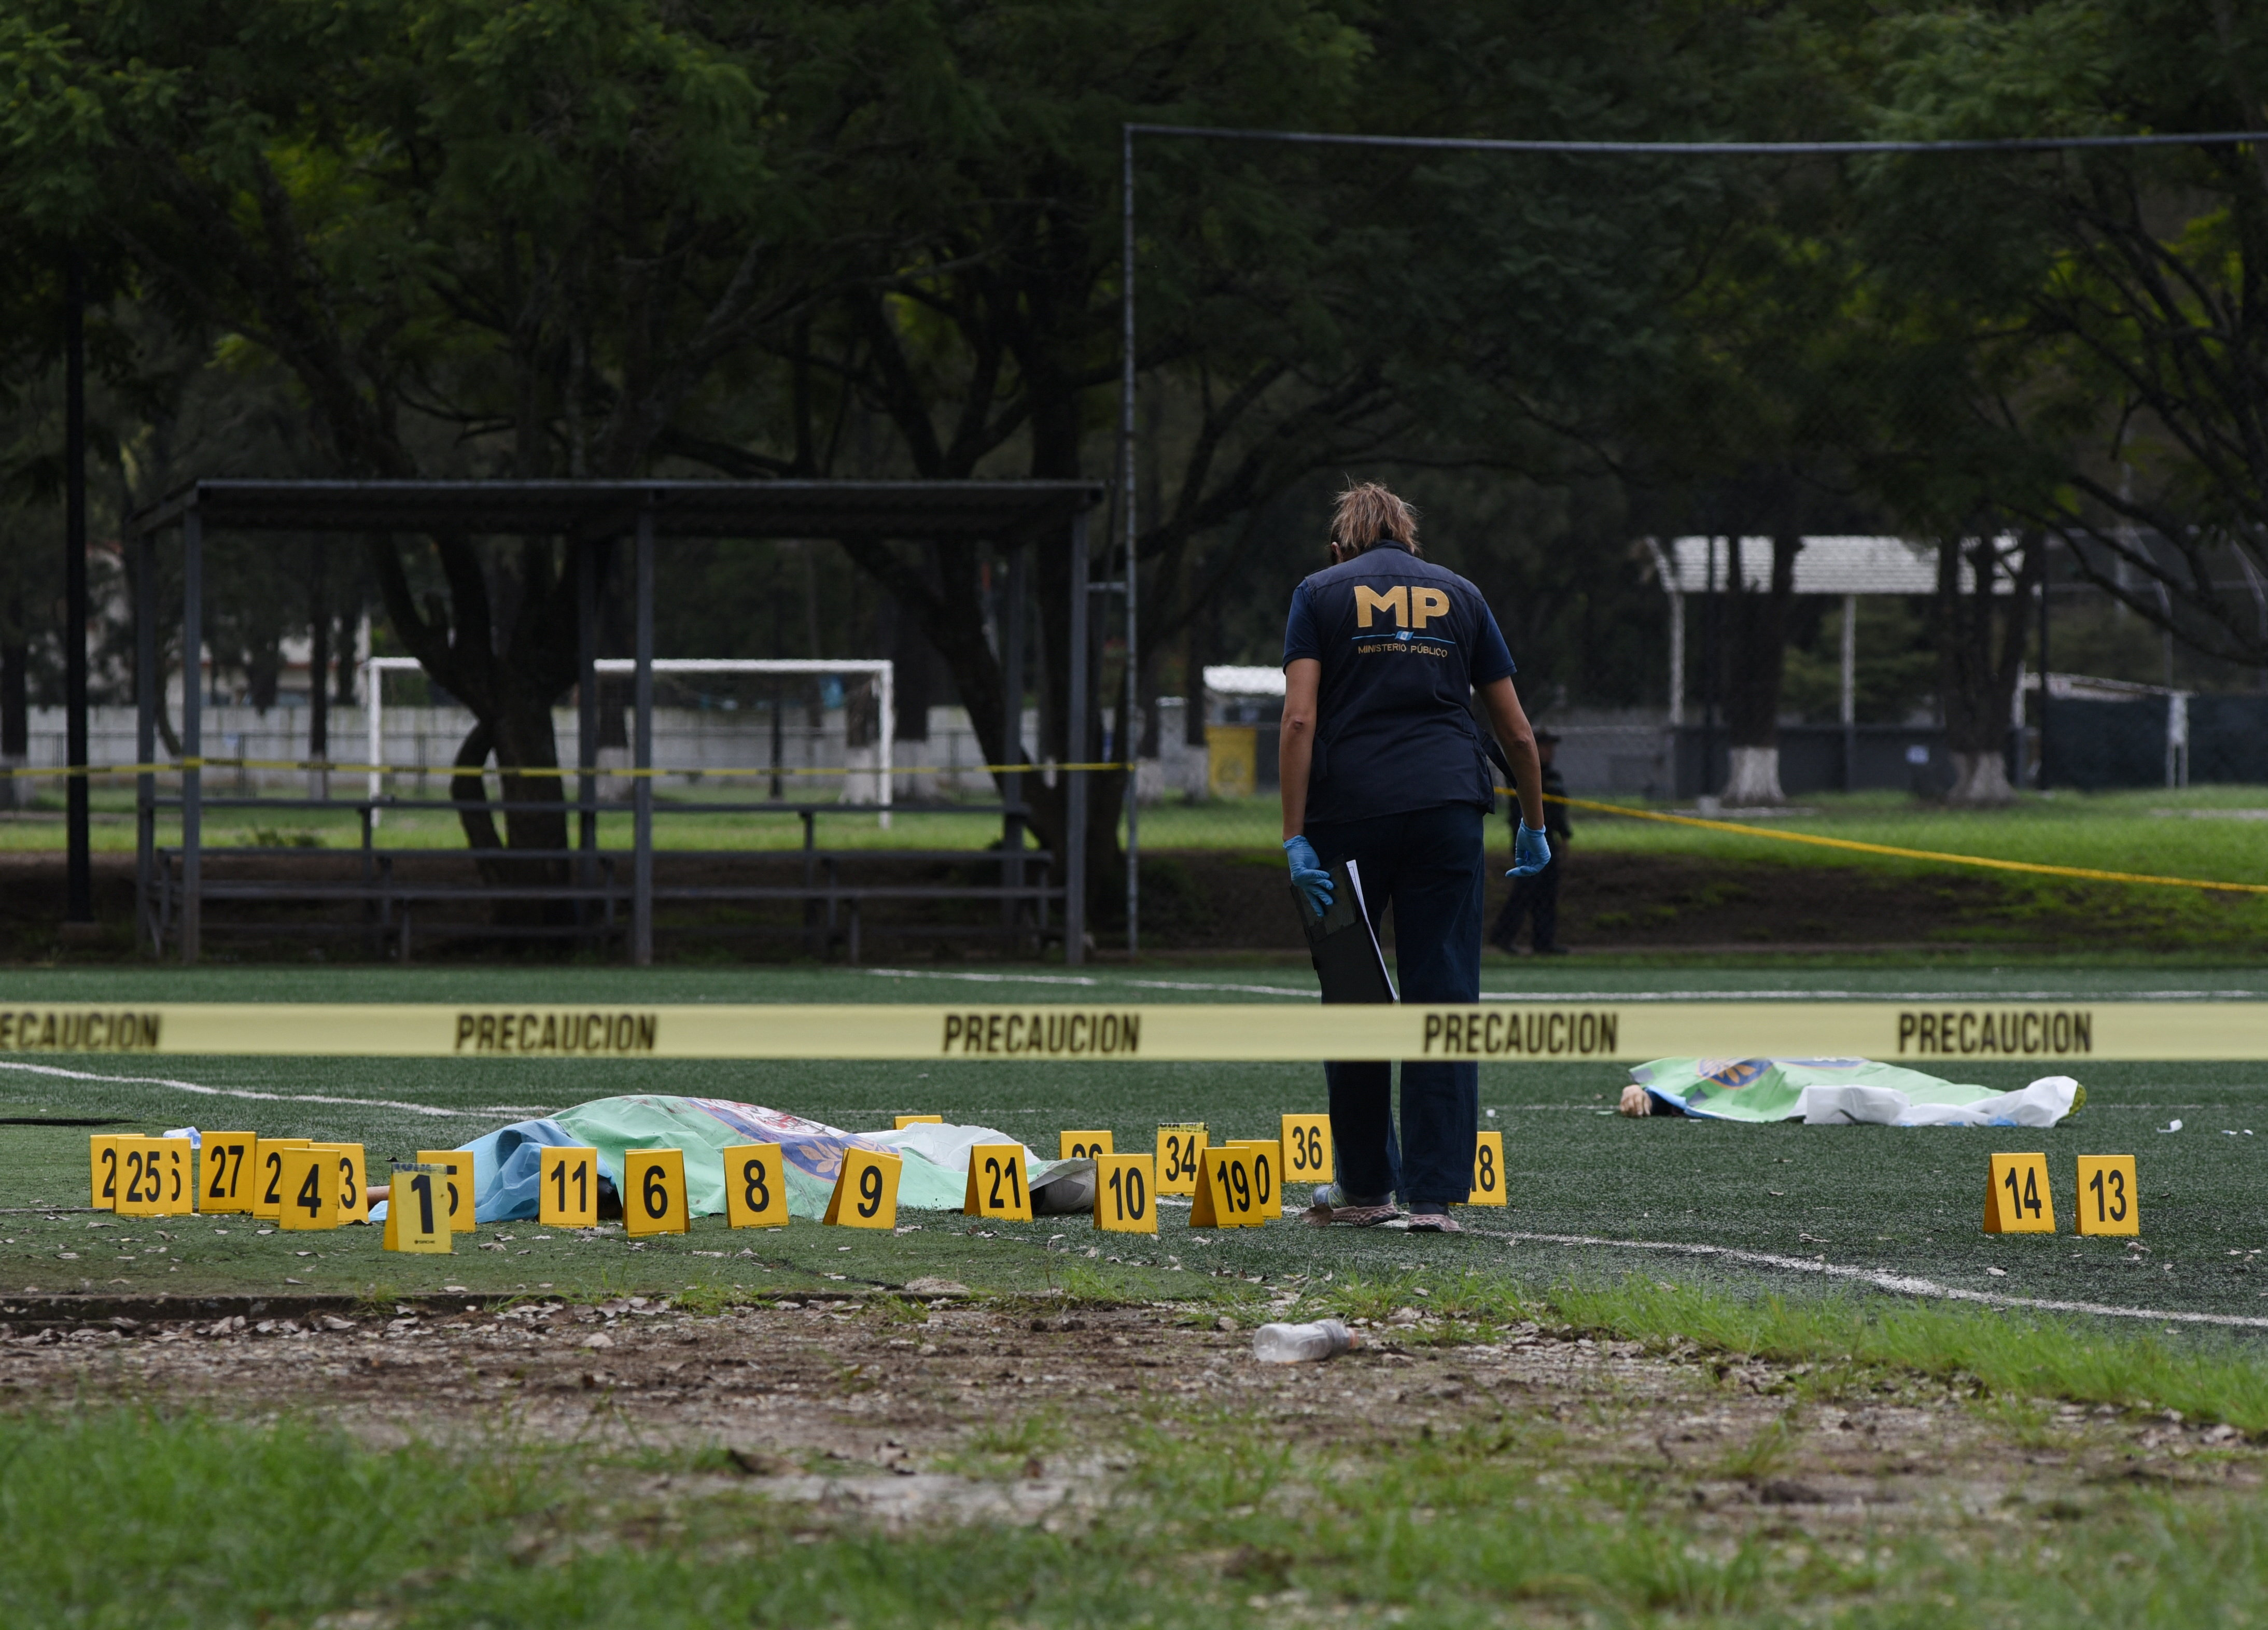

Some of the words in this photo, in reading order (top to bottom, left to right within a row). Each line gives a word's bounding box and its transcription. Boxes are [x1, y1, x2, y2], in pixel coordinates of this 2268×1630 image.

[1354, 585, 1450, 628] MP
[1358, 643, 1407, 654] MINISTERIO
[1410, 643, 1448, 658] PÚBLICO
[454, 1013, 657, 1052] PRECAUCION
[943, 1013, 1140, 1053] PRECAUCION
[1423, 1012, 1618, 1054] PRECAUCION
[1897, 1011, 2093, 1053] PRECAUCION
[102, 1148, 116, 1197] 2
[209, 1146, 244, 1197] 27
[1166, 1136, 1197, 1181] 34
[1293, 1127, 1322, 1169] 36
[127, 1151, 160, 1202] 25
[172, 1151, 180, 1201] 6
[264, 1153, 281, 1203] 2
[298, 1164, 321, 1218] 4
[340, 1158, 356, 1209] 3
[552, 1161, 586, 1212] 11
[643, 1165, 667, 1219] 6
[744, 1160, 769, 1212] 8
[858, 1166, 882, 1217] 9
[986, 1157, 1020, 1208] 21
[1110, 1168, 1144, 1220] 10
[1217, 1161, 1250, 1212] 19
[1255, 1155, 1269, 1204] 0
[2006, 1168, 2041, 1218] 14
[2090, 1170, 2126, 1221] 13
[411, 1174, 433, 1233] 1
